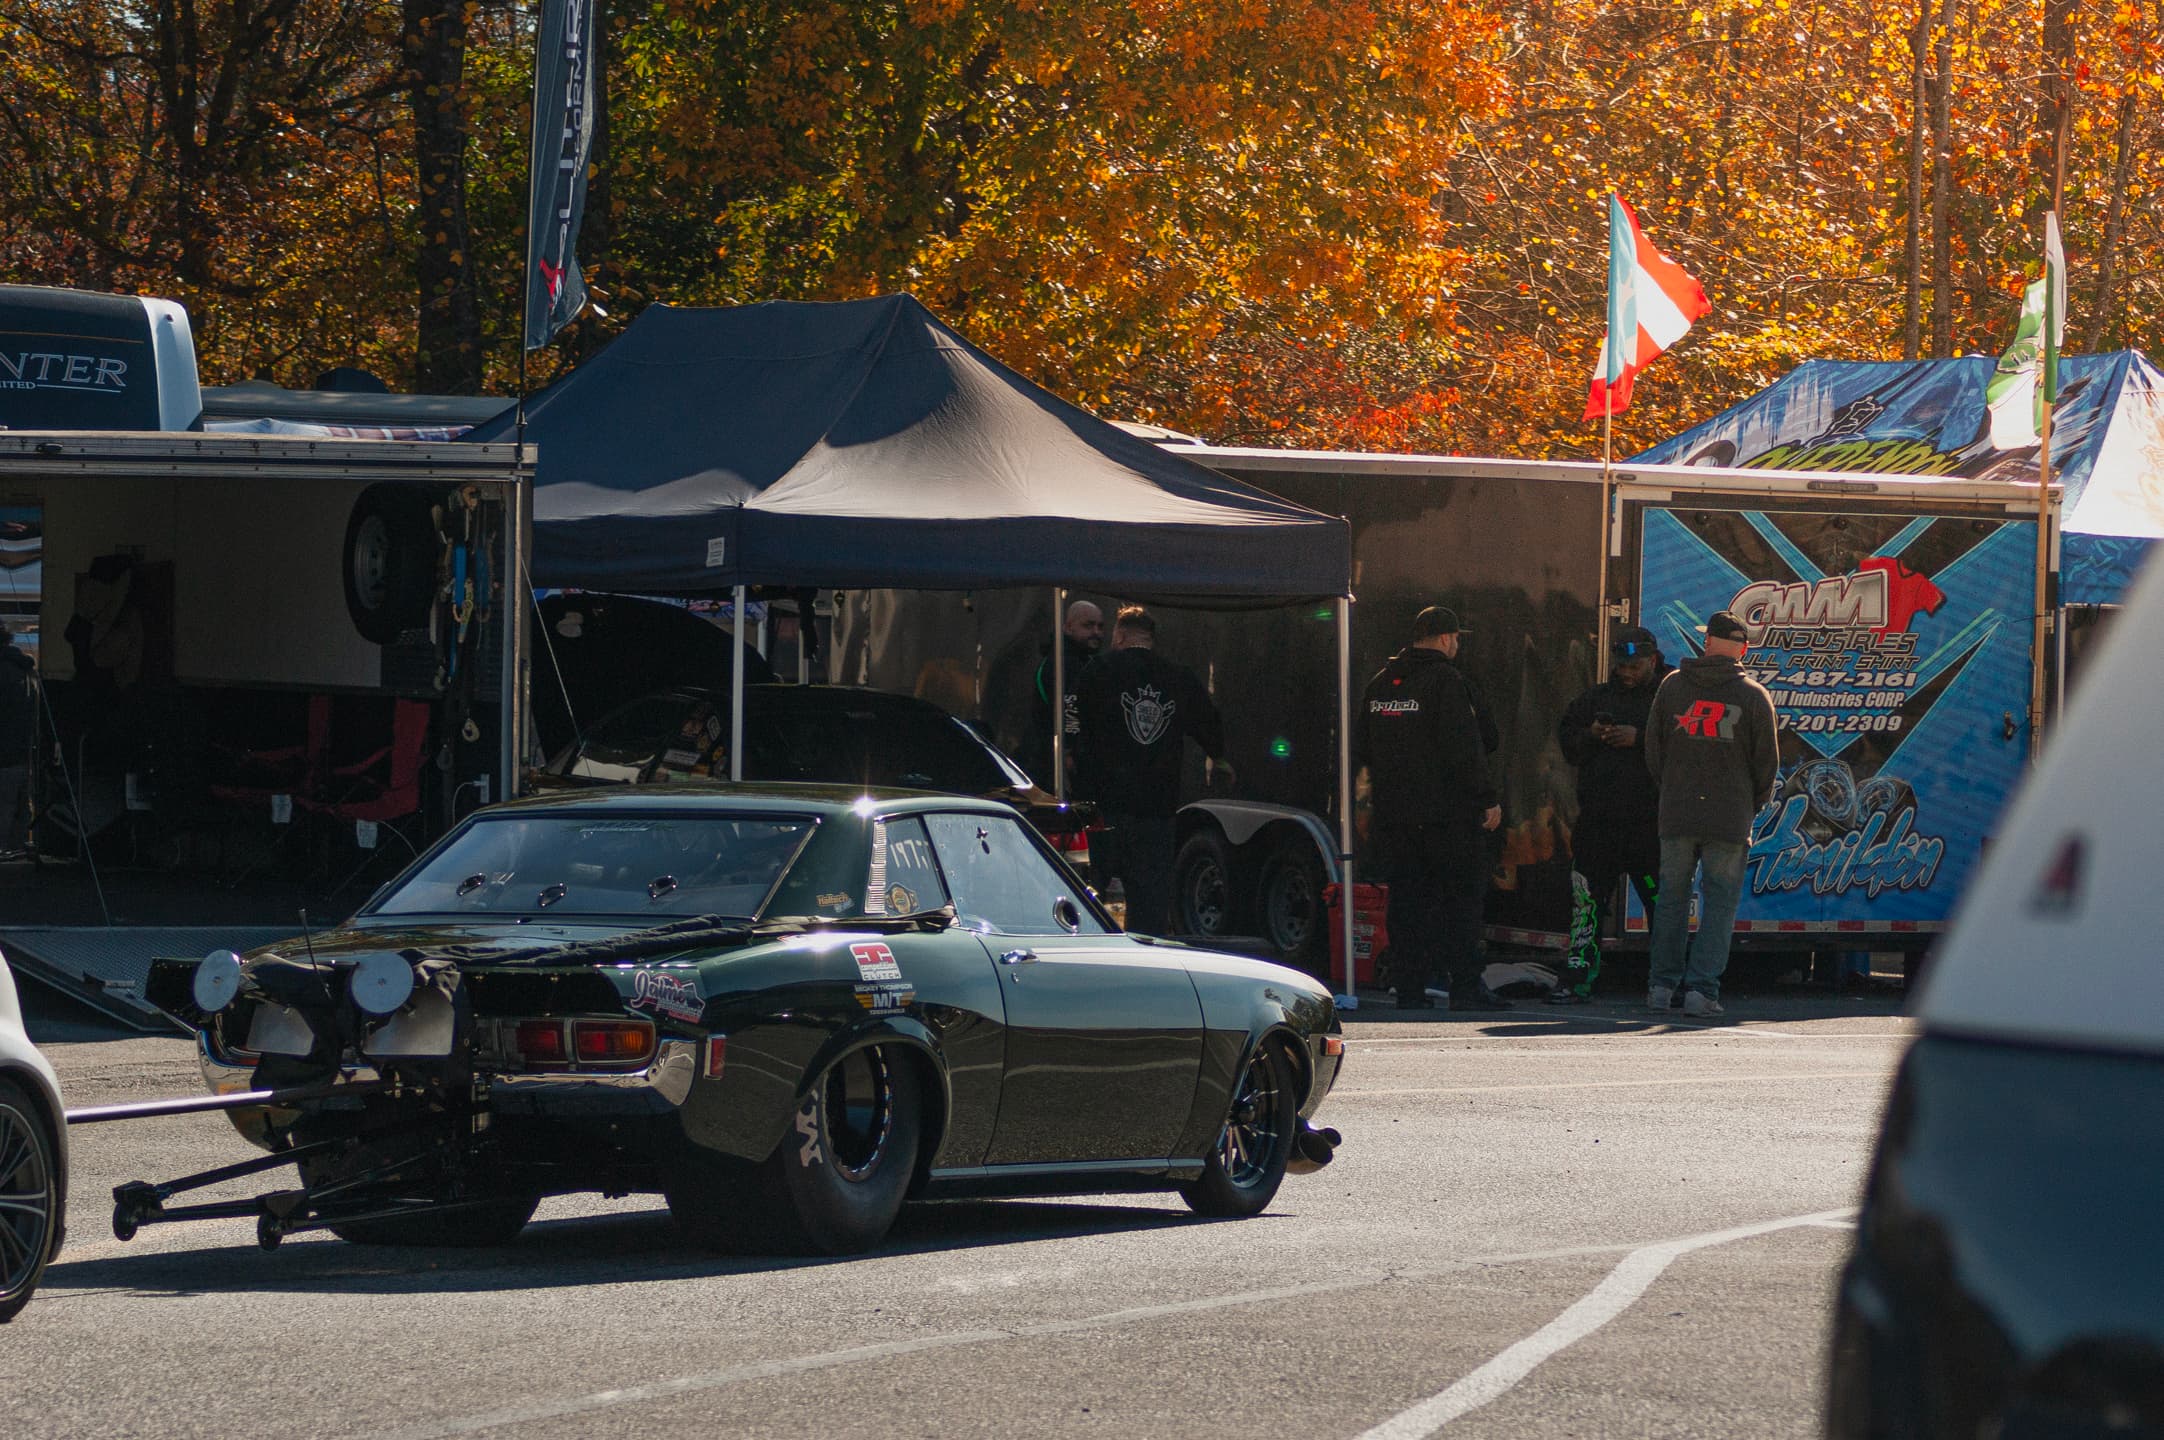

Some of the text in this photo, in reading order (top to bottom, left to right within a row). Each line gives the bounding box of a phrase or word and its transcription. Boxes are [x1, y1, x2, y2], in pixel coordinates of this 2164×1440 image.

[1764, 627, 1920, 656] INDUSTRIES
[1786, 655, 1851, 669] PRINT
[1854, 656, 1921, 670] SHIRT
[1789, 692, 1861, 707] Industries
[1865, 692, 1903, 707] CORP.
[873, 991, 902, 1009] M/T
